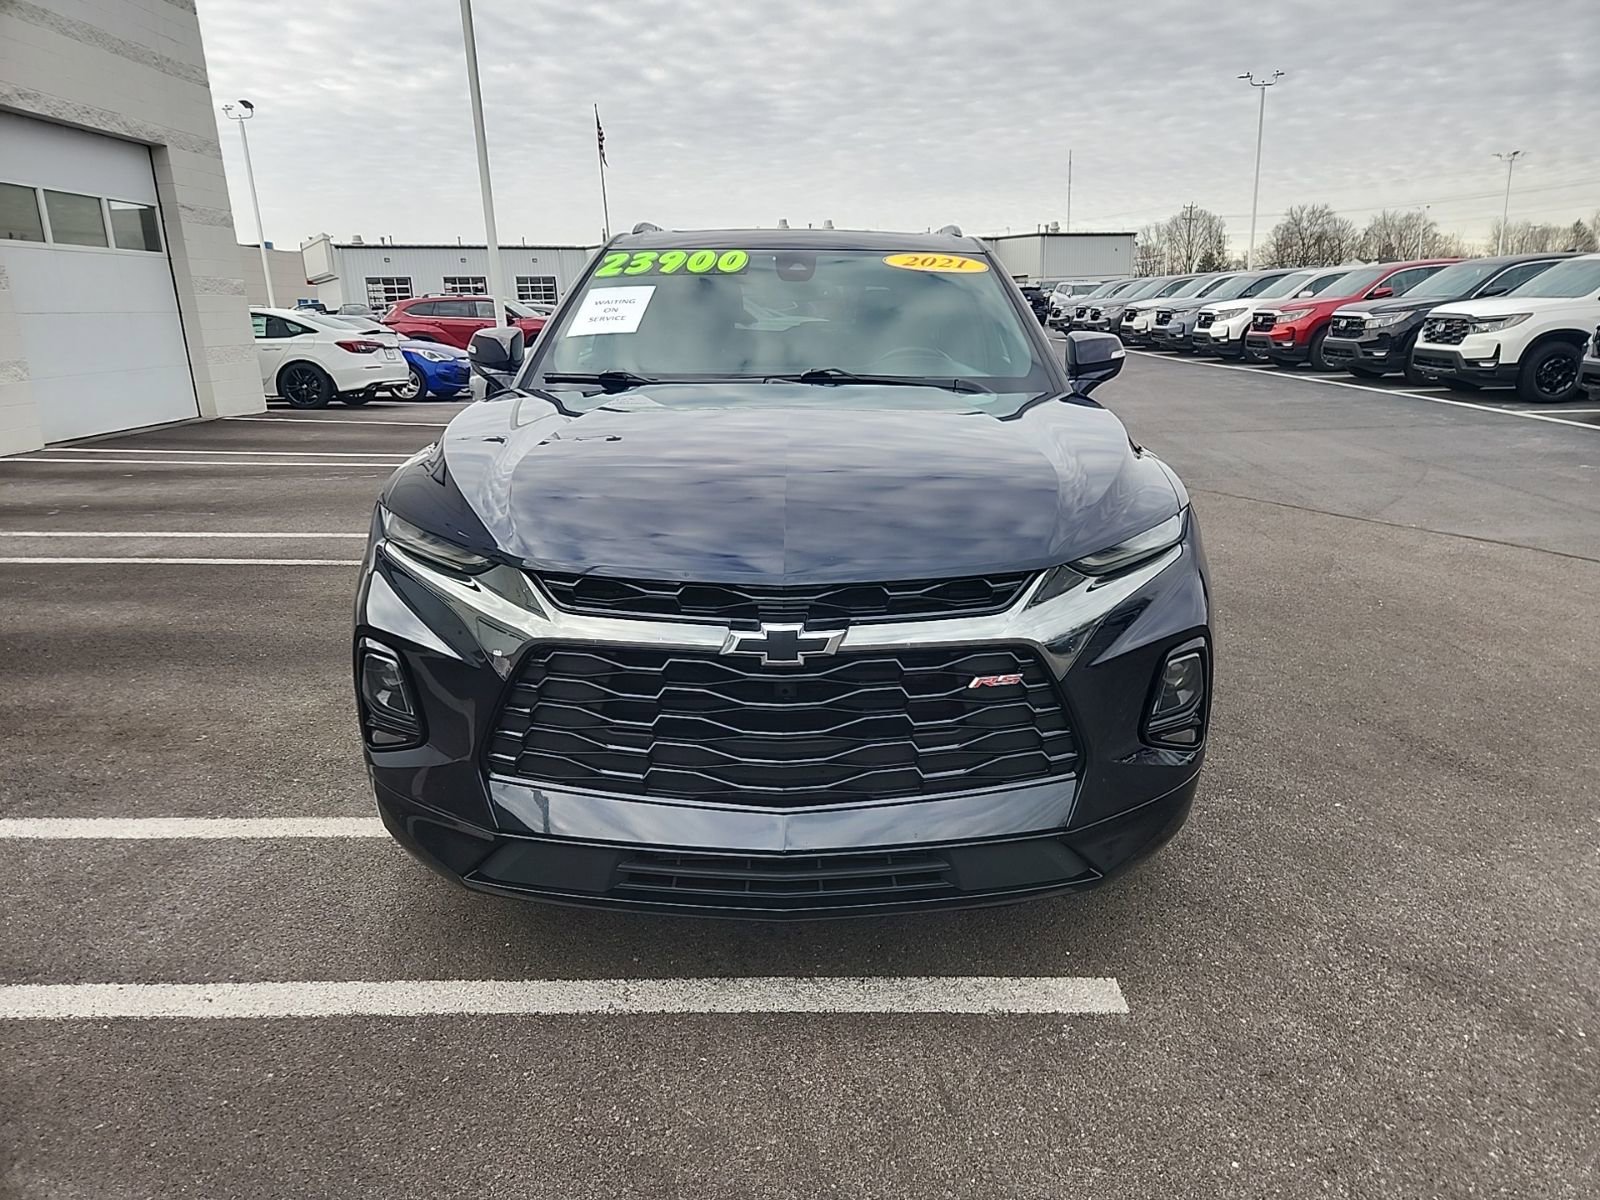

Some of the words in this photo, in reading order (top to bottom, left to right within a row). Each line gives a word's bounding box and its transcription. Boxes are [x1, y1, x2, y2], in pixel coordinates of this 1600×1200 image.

[595, 250, 748, 276] 23900
[902, 256, 967, 268] 2021
[594, 298, 636, 306] WAITING
[588, 315, 627, 323] SERVICE
[968, 673, 1023, 688] RS
